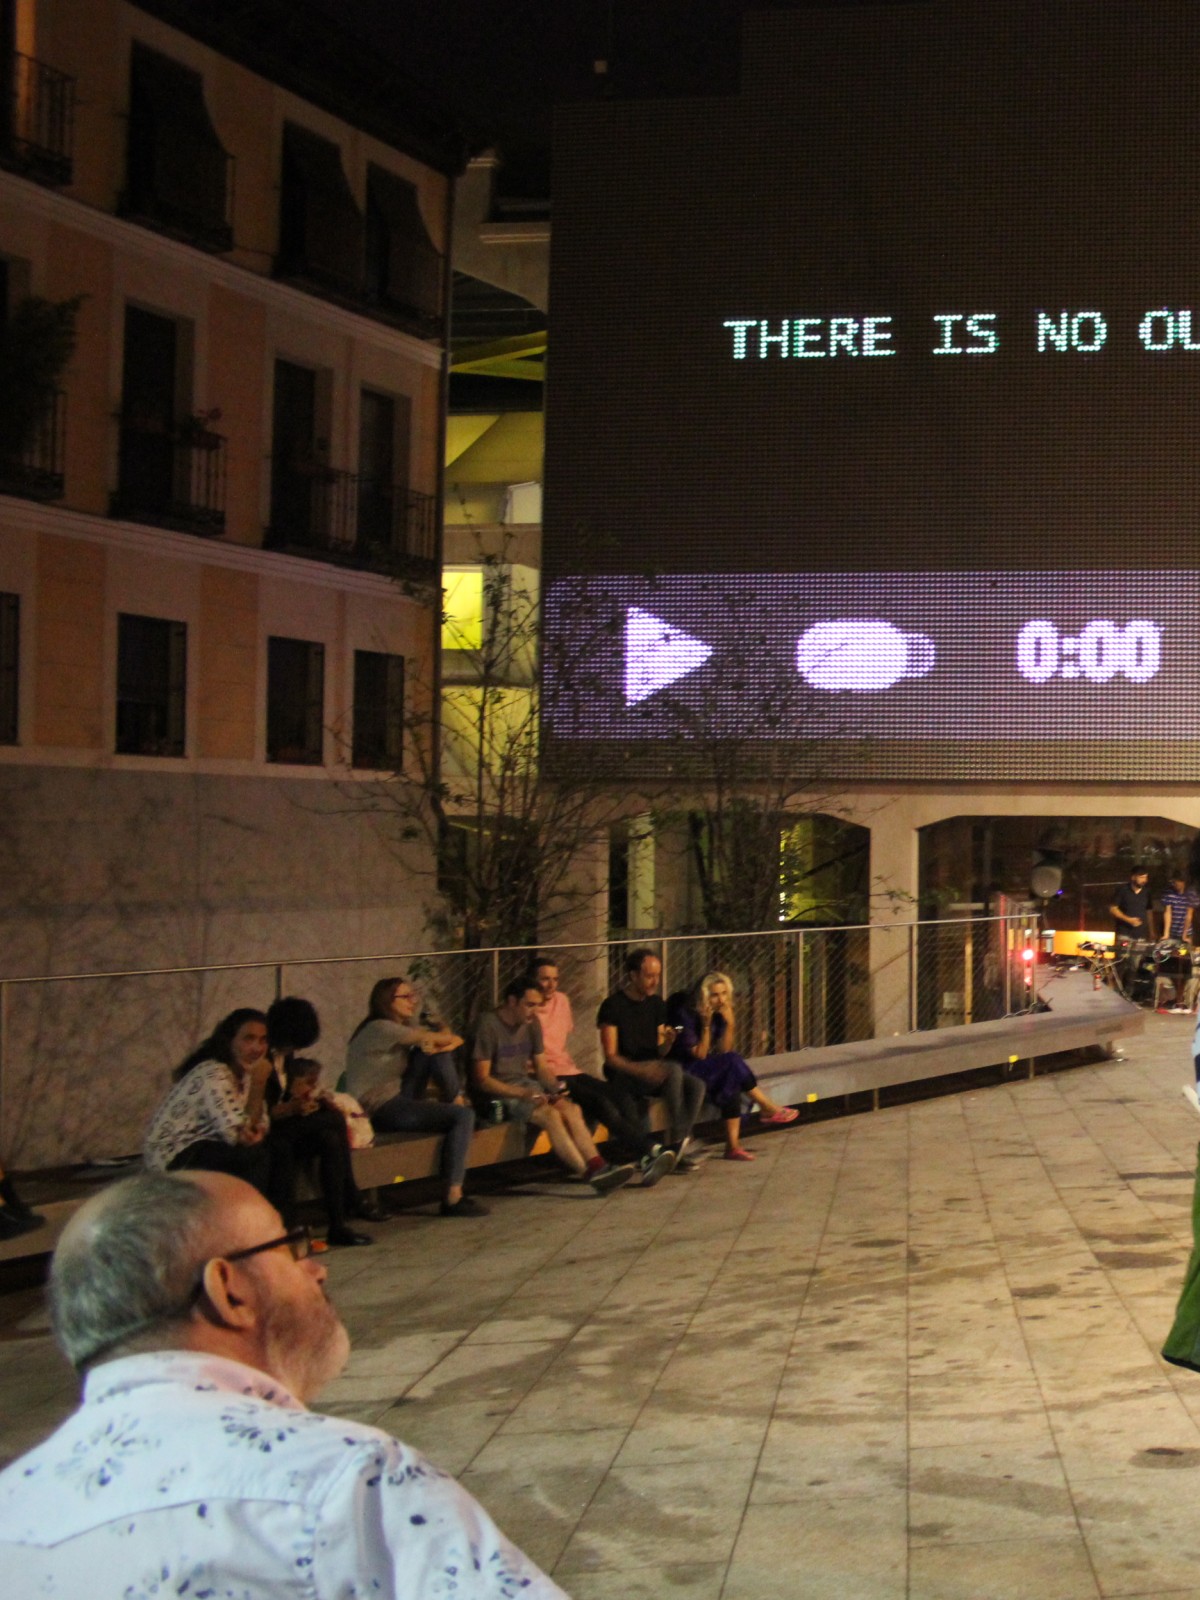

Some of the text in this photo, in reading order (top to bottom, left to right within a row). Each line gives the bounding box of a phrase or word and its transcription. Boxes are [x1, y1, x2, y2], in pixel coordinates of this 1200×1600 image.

[722, 316, 896, 360] THERE
[932, 313, 1000, 355] IS
[1036, 310, 1108, 353] NO
[1015, 619, 1164, 684] 0:00
